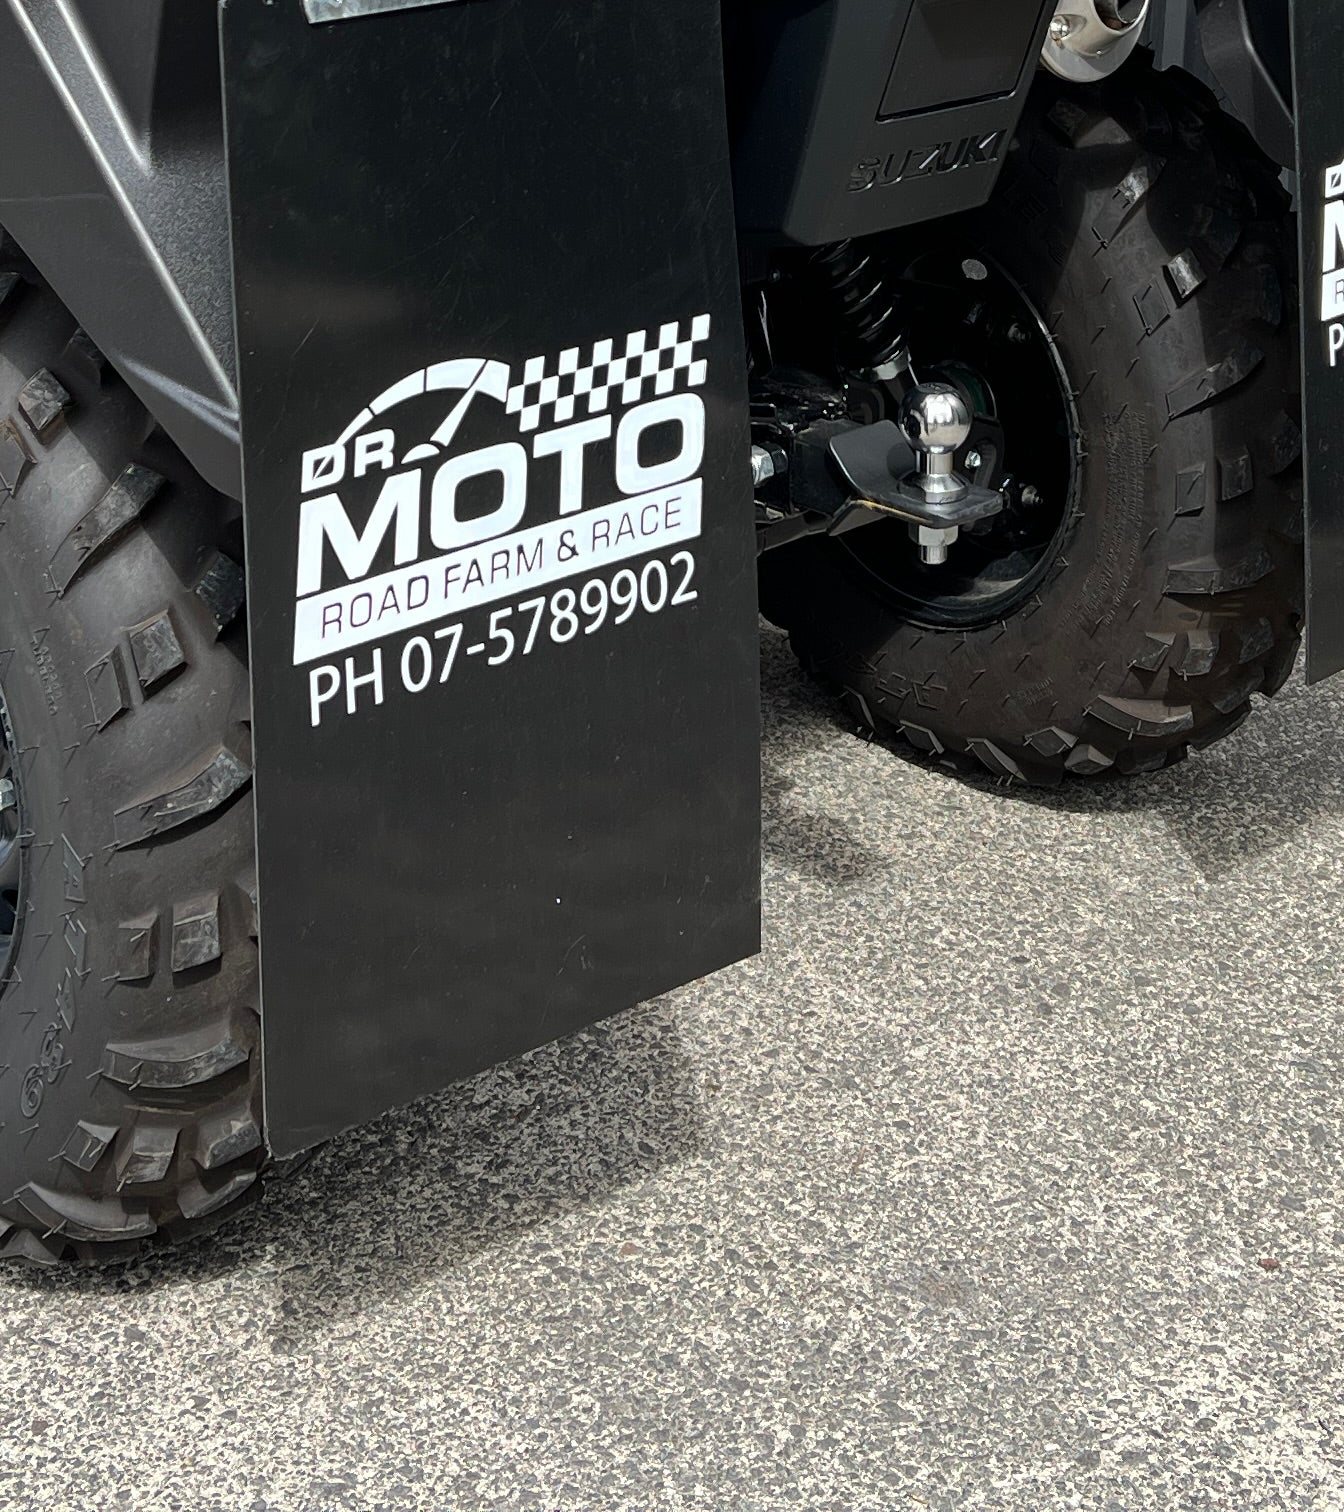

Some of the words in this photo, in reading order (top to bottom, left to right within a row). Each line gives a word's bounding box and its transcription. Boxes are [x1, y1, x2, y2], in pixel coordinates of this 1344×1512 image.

[847, 128, 1009, 193] SUZUKI
[296, 392, 706, 598] MOTO
[300, 428, 395, 494] DR
[309, 646, 385, 728] PH
[400, 550, 699, 694] 07-5789902
[320, 574, 430, 639] ROAD
[443, 539, 544, 599] FARM
[557, 529, 579, 563] &
[591, 496, 683, 554] RACE
